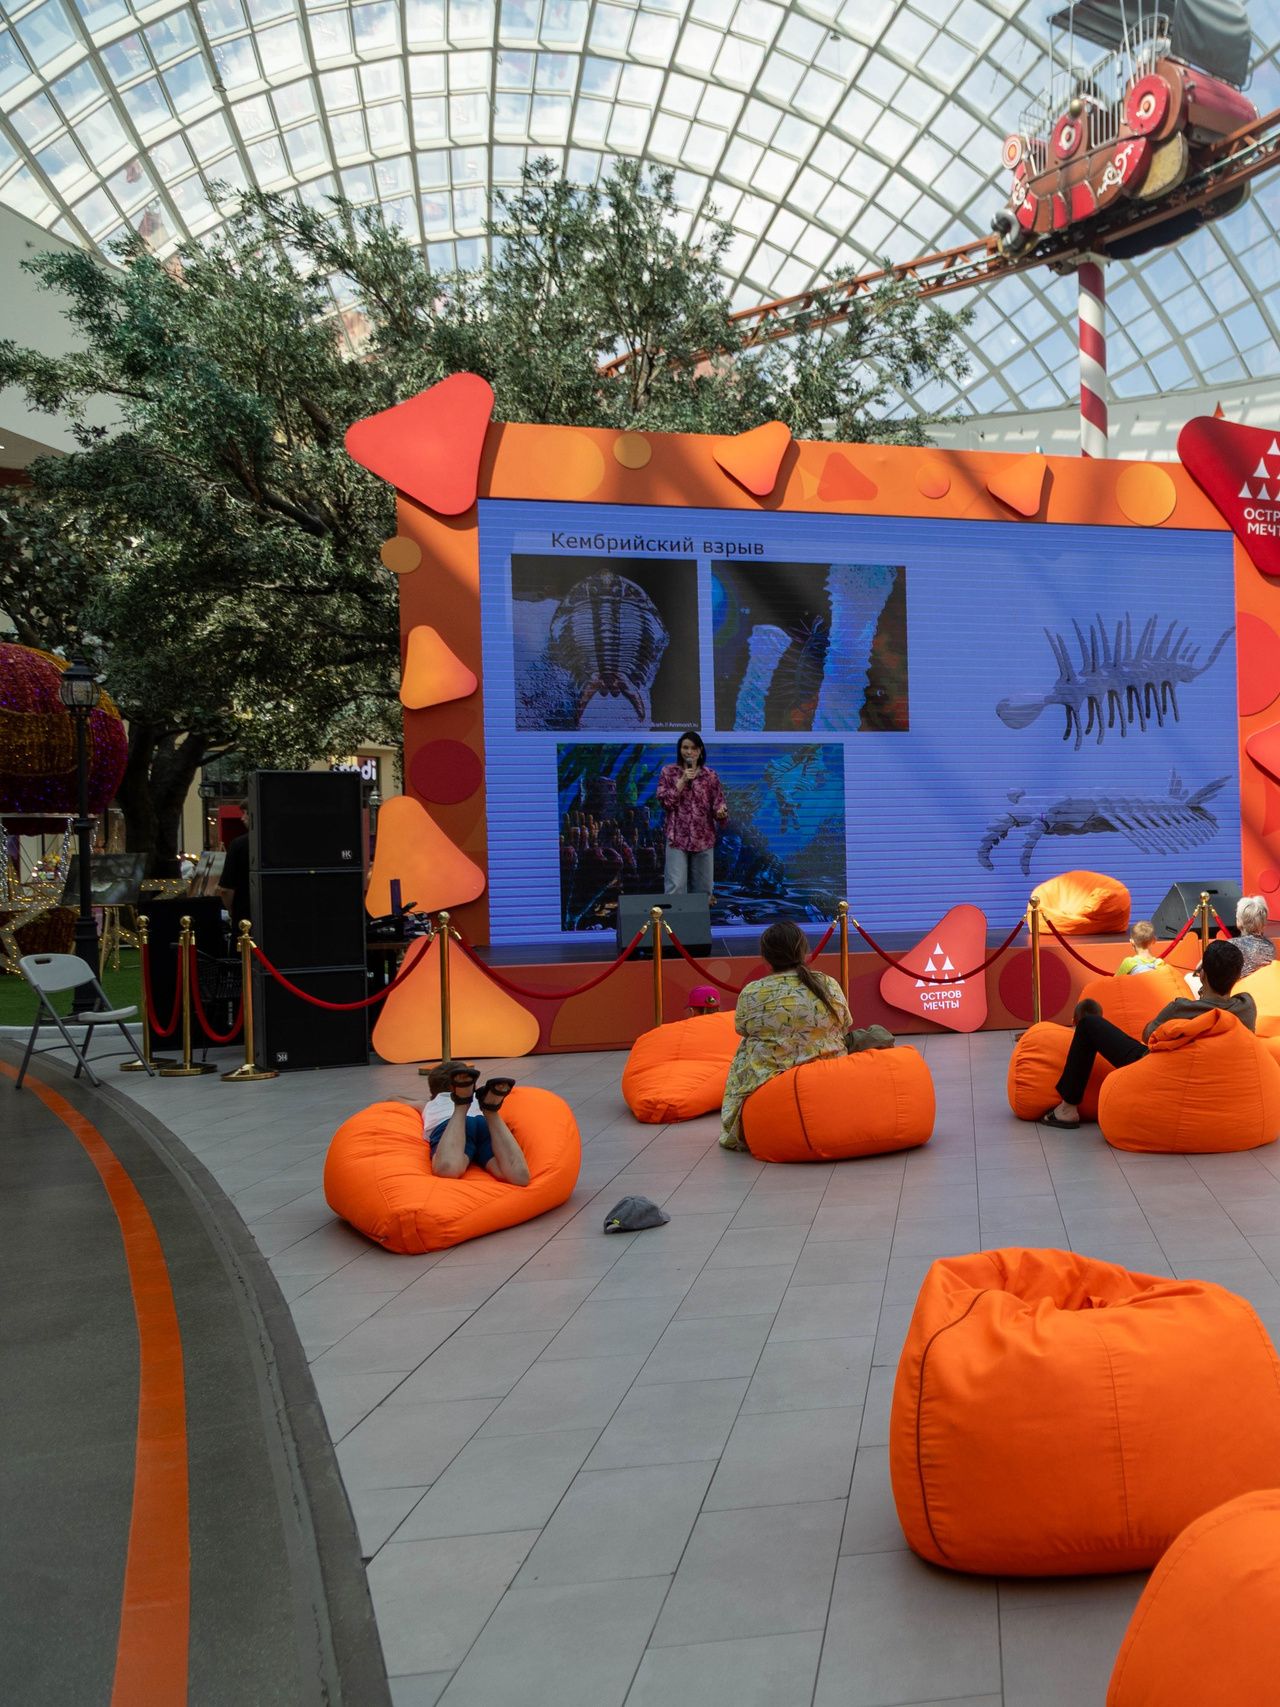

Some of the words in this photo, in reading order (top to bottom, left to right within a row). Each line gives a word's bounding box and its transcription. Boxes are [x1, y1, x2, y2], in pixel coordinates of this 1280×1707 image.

[551, 532, 694, 553] Кембрийский
[703, 541, 765, 557] взрыв
[920, 990, 962, 1001] ОСТРОВ
[923, 1000, 960, 1010] МЕЧТЫ
